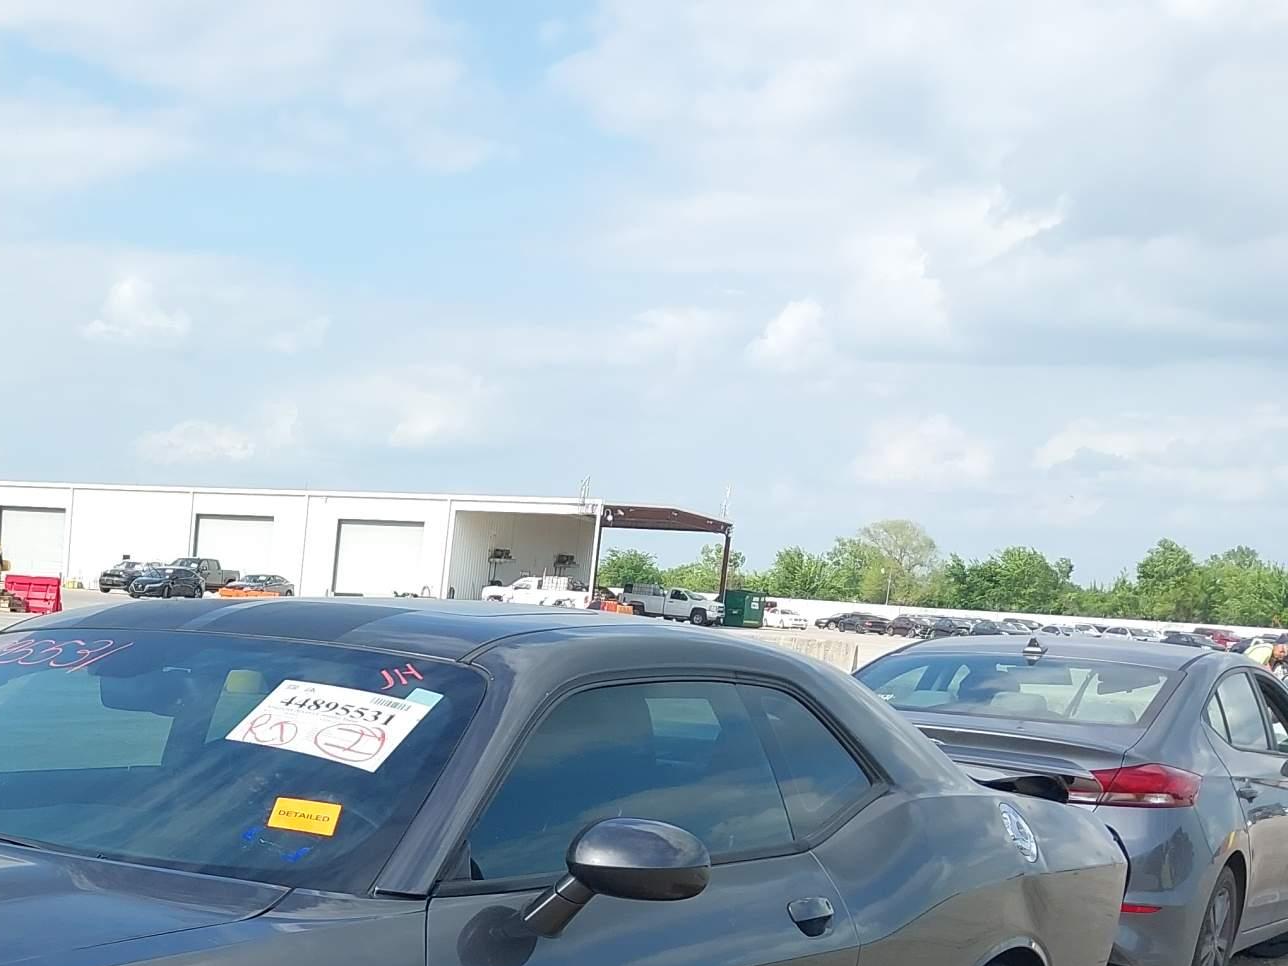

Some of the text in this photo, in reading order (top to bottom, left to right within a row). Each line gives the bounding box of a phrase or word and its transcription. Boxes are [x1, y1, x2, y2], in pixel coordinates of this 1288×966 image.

[381, 663, 424, 690] JH
[280, 695, 396, 726] 44895531
[278, 809, 330, 823] DETAILED
